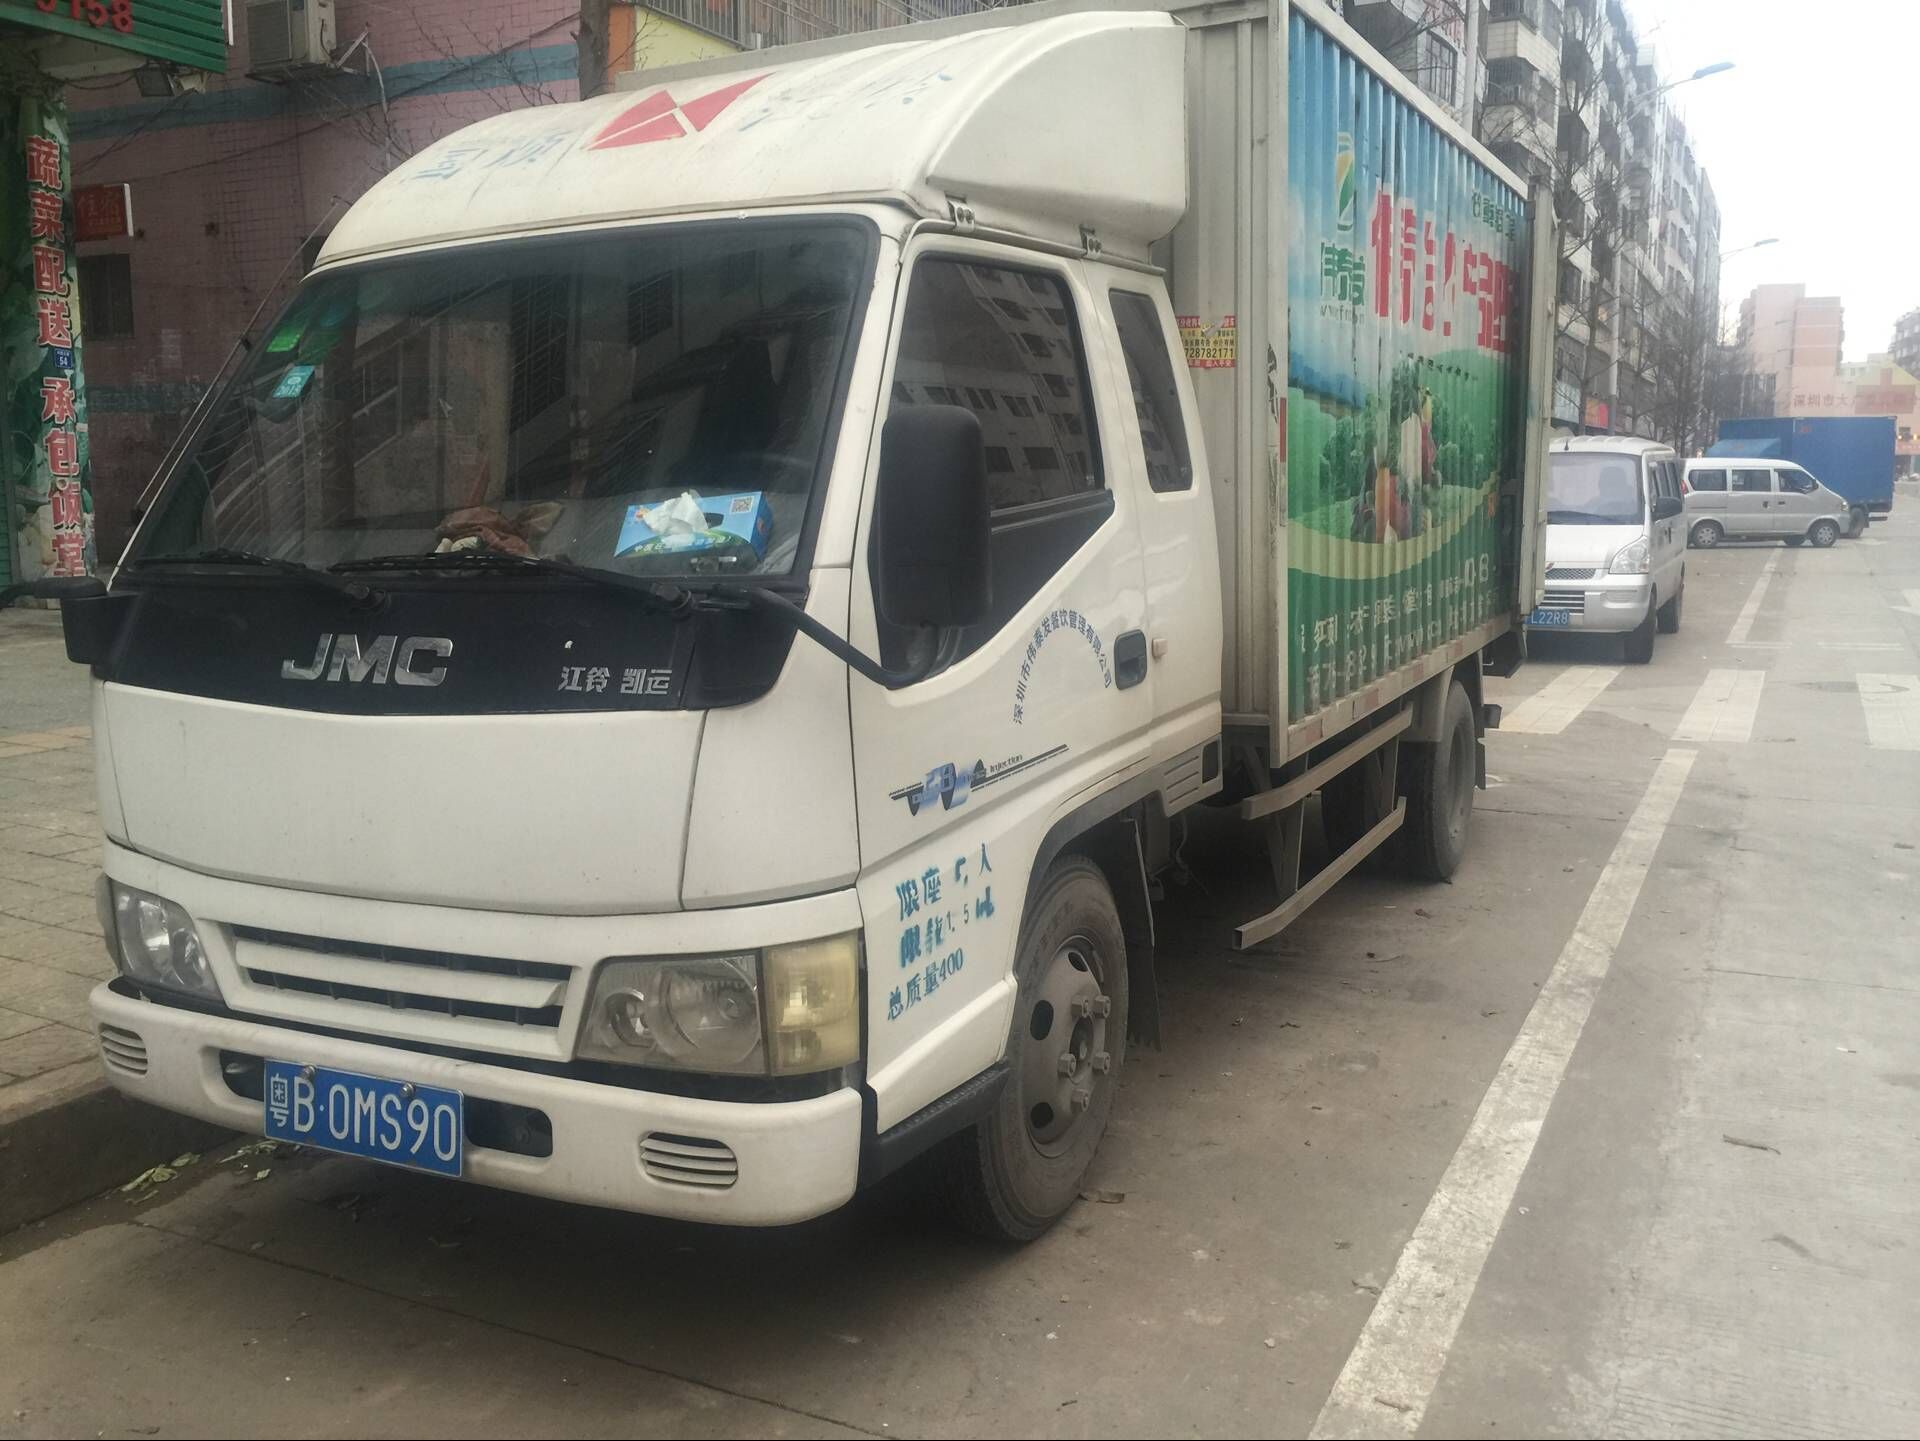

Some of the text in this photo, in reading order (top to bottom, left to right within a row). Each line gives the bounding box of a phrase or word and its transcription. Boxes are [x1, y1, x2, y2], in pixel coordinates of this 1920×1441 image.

[26, 134, 73, 349] 蔬菜配送
[281, 633, 454, 687] JMC
[558, 665, 673, 695] 江铃 凯运
[1013, 608, 1112, 725] 深圳市伟泰发餐饮管理有限公司
